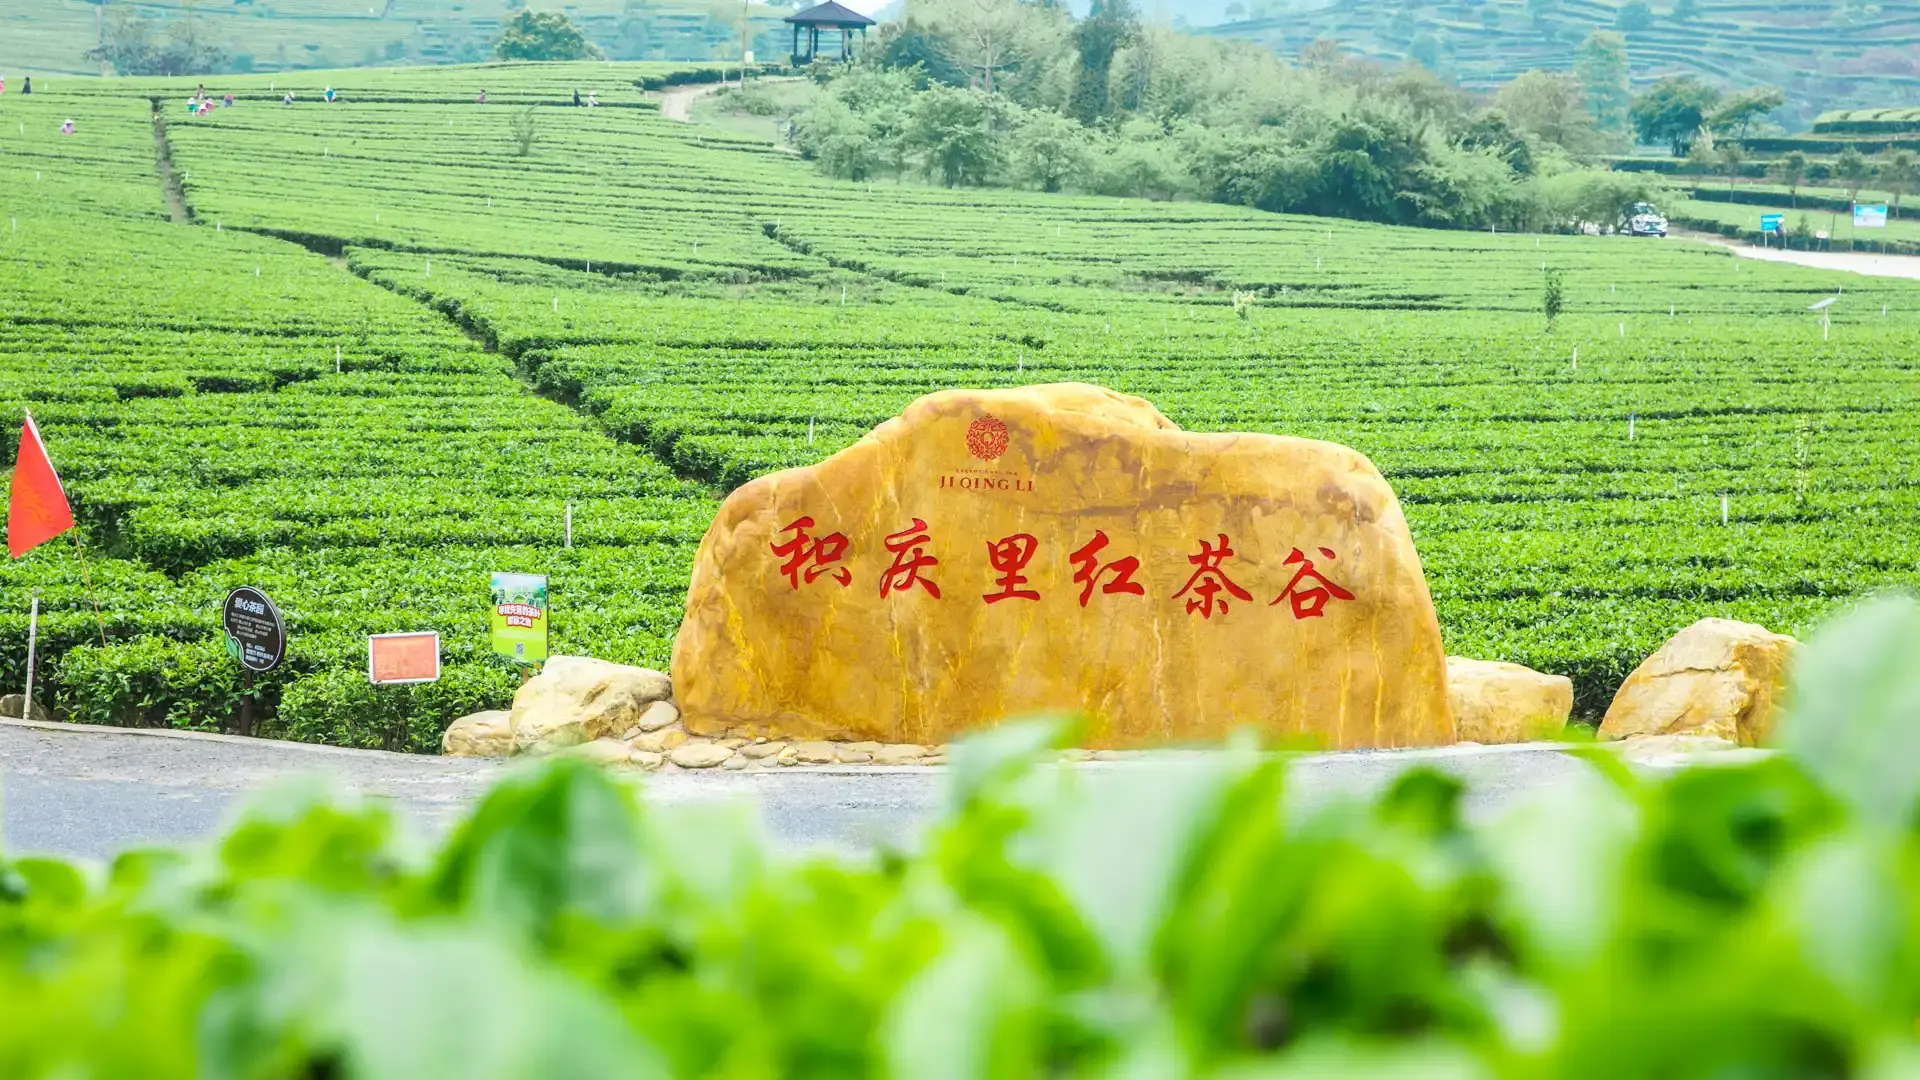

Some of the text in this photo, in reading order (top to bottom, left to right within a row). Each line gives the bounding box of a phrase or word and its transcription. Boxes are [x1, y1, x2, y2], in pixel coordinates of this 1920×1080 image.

[960, 477, 1010, 491] QING
[1016, 480, 1033, 492] LI
[771, 515, 1356, 620] 积庆里红茶谷
[234, 597, 265, 615] 爱心茶园
